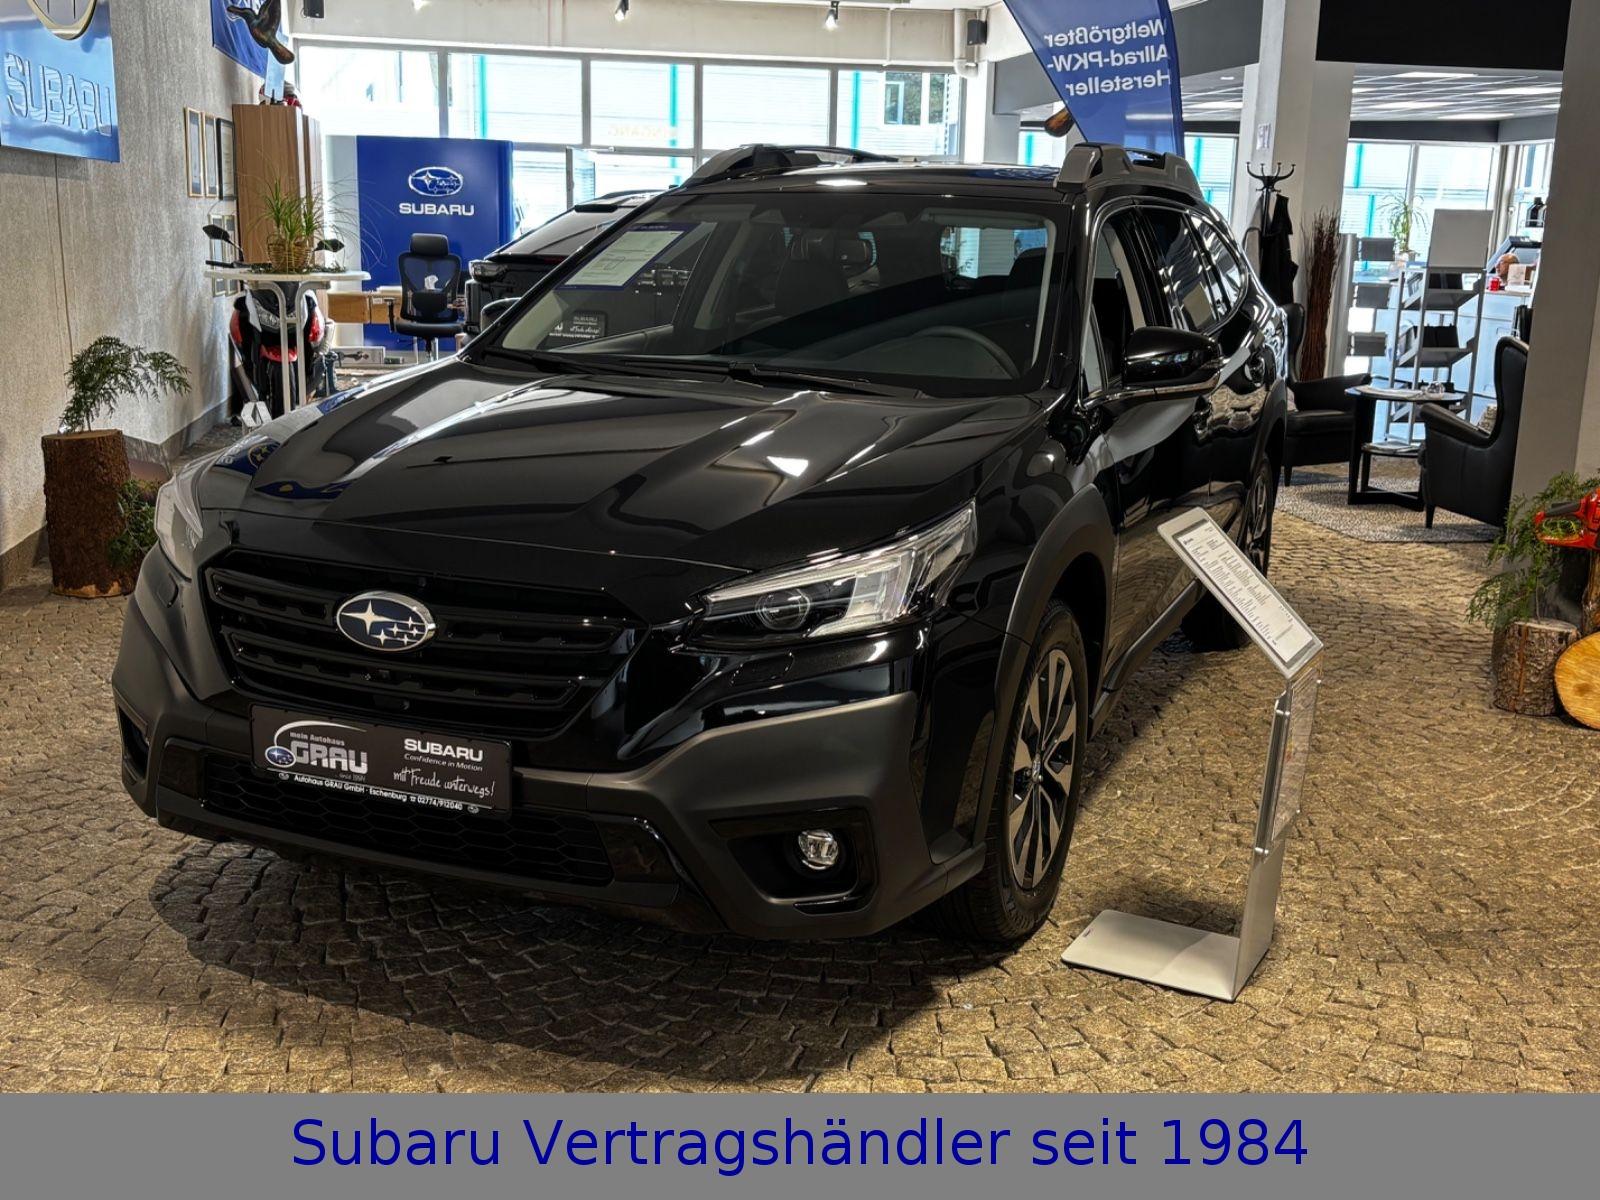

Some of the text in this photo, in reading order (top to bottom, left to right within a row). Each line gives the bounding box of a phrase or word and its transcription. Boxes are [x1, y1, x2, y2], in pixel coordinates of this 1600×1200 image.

[4, 52, 113, 137] SUBARU
[398, 202, 475, 216] SUBARU
[309, 734, 345, 746] Autohaus
[404, 738, 483, 762] SUBARU
[290, 740, 368, 774] GRAU
[404, 753, 447, 765] Confidence
[456, 762, 483, 772] Motion
[293, 774, 323, 786] Autohaus
[324, 780, 343, 789] GRAU
[343, 782, 365, 794] GmbH
[369, 787, 407, 801] Eschenburg
[410, 768, 441, 788] Freude
[444, 775, 496, 798] unterwegs!
